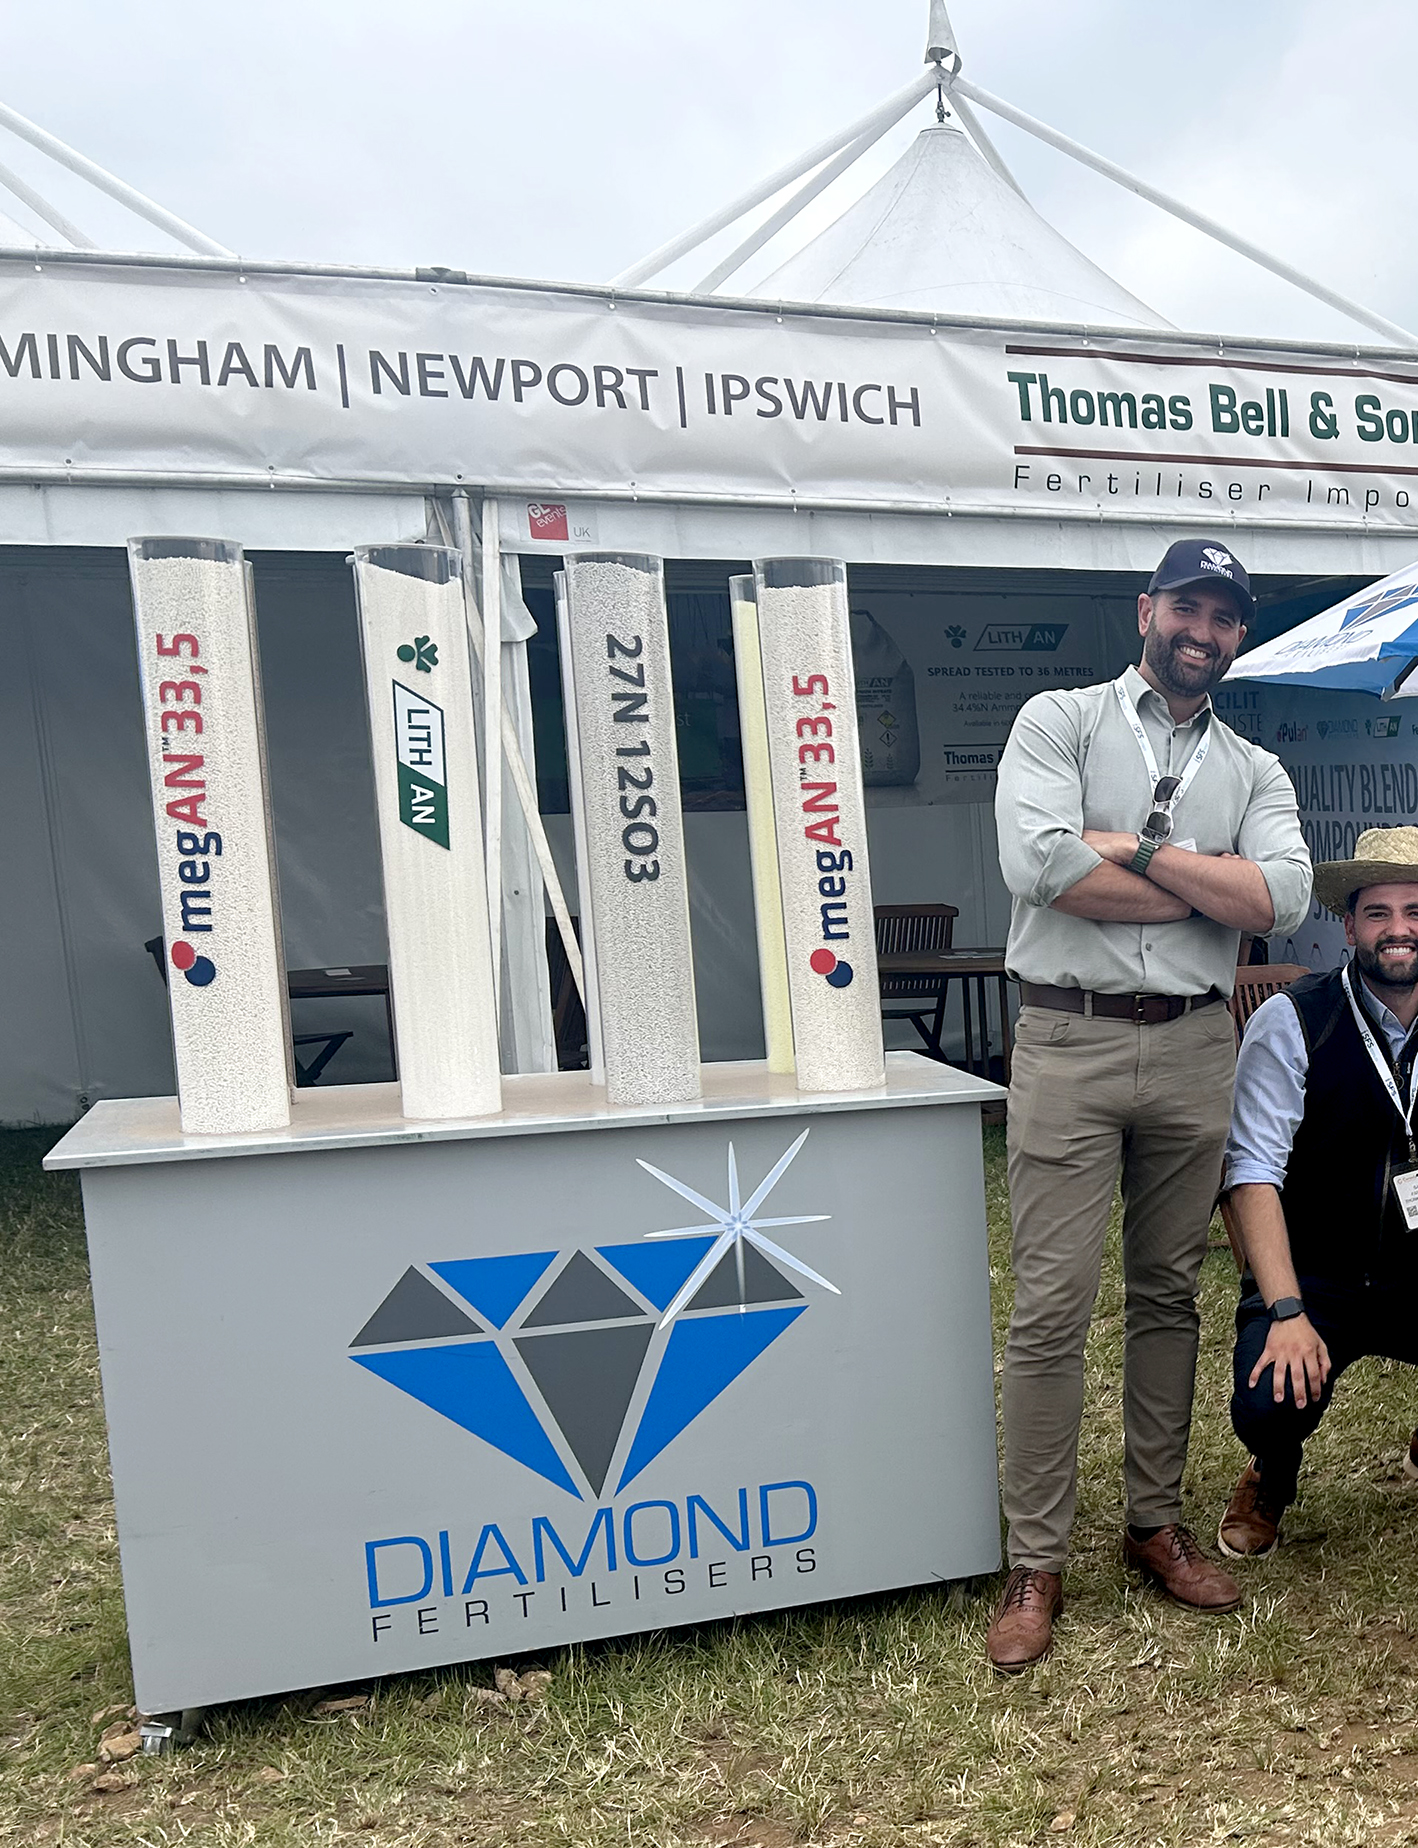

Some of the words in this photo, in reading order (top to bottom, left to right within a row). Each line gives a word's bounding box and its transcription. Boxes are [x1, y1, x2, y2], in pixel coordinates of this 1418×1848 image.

[369, 350, 659, 412] NEWPORT
[705, 371, 922, 428] IPSWICH
[1007, 371, 1193, 432] Thomas
[1209, 383, 1290, 438] Bell
[1308, 391, 1340, 442] &
[1013, 464, 1272, 502] Fertiliser
[528, 503, 550, 519] GL
[536, 506, 567, 527] events
[573, 526, 591, 538] UK
[988, 630, 1023, 644] LITH
[1033, 630, 1056, 644] AN
[156, 632, 209, 735] 33,5
[606, 633, 650, 723] 27N
[927, 666, 971, 677] SPREAD
[975, 666, 1014, 677] TESTED
[1018, 666, 1034, 677] TO
[1037, 666, 1050, 677] 36
[1054, 666, 1094, 677] METRES
[959, 691, 967, 701] A
[968, 690, 1002, 701] reliable
[1004, 690, 1022, 701] and
[406, 708, 432, 767] LITH
[792, 674, 838, 765] 33,5
[944, 750, 994, 766] Thomas
[410, 782, 436, 826] AN
[364, 1479, 819, 1610] DIAMOND
[371, 1547, 818, 1643] FERTILISERS
